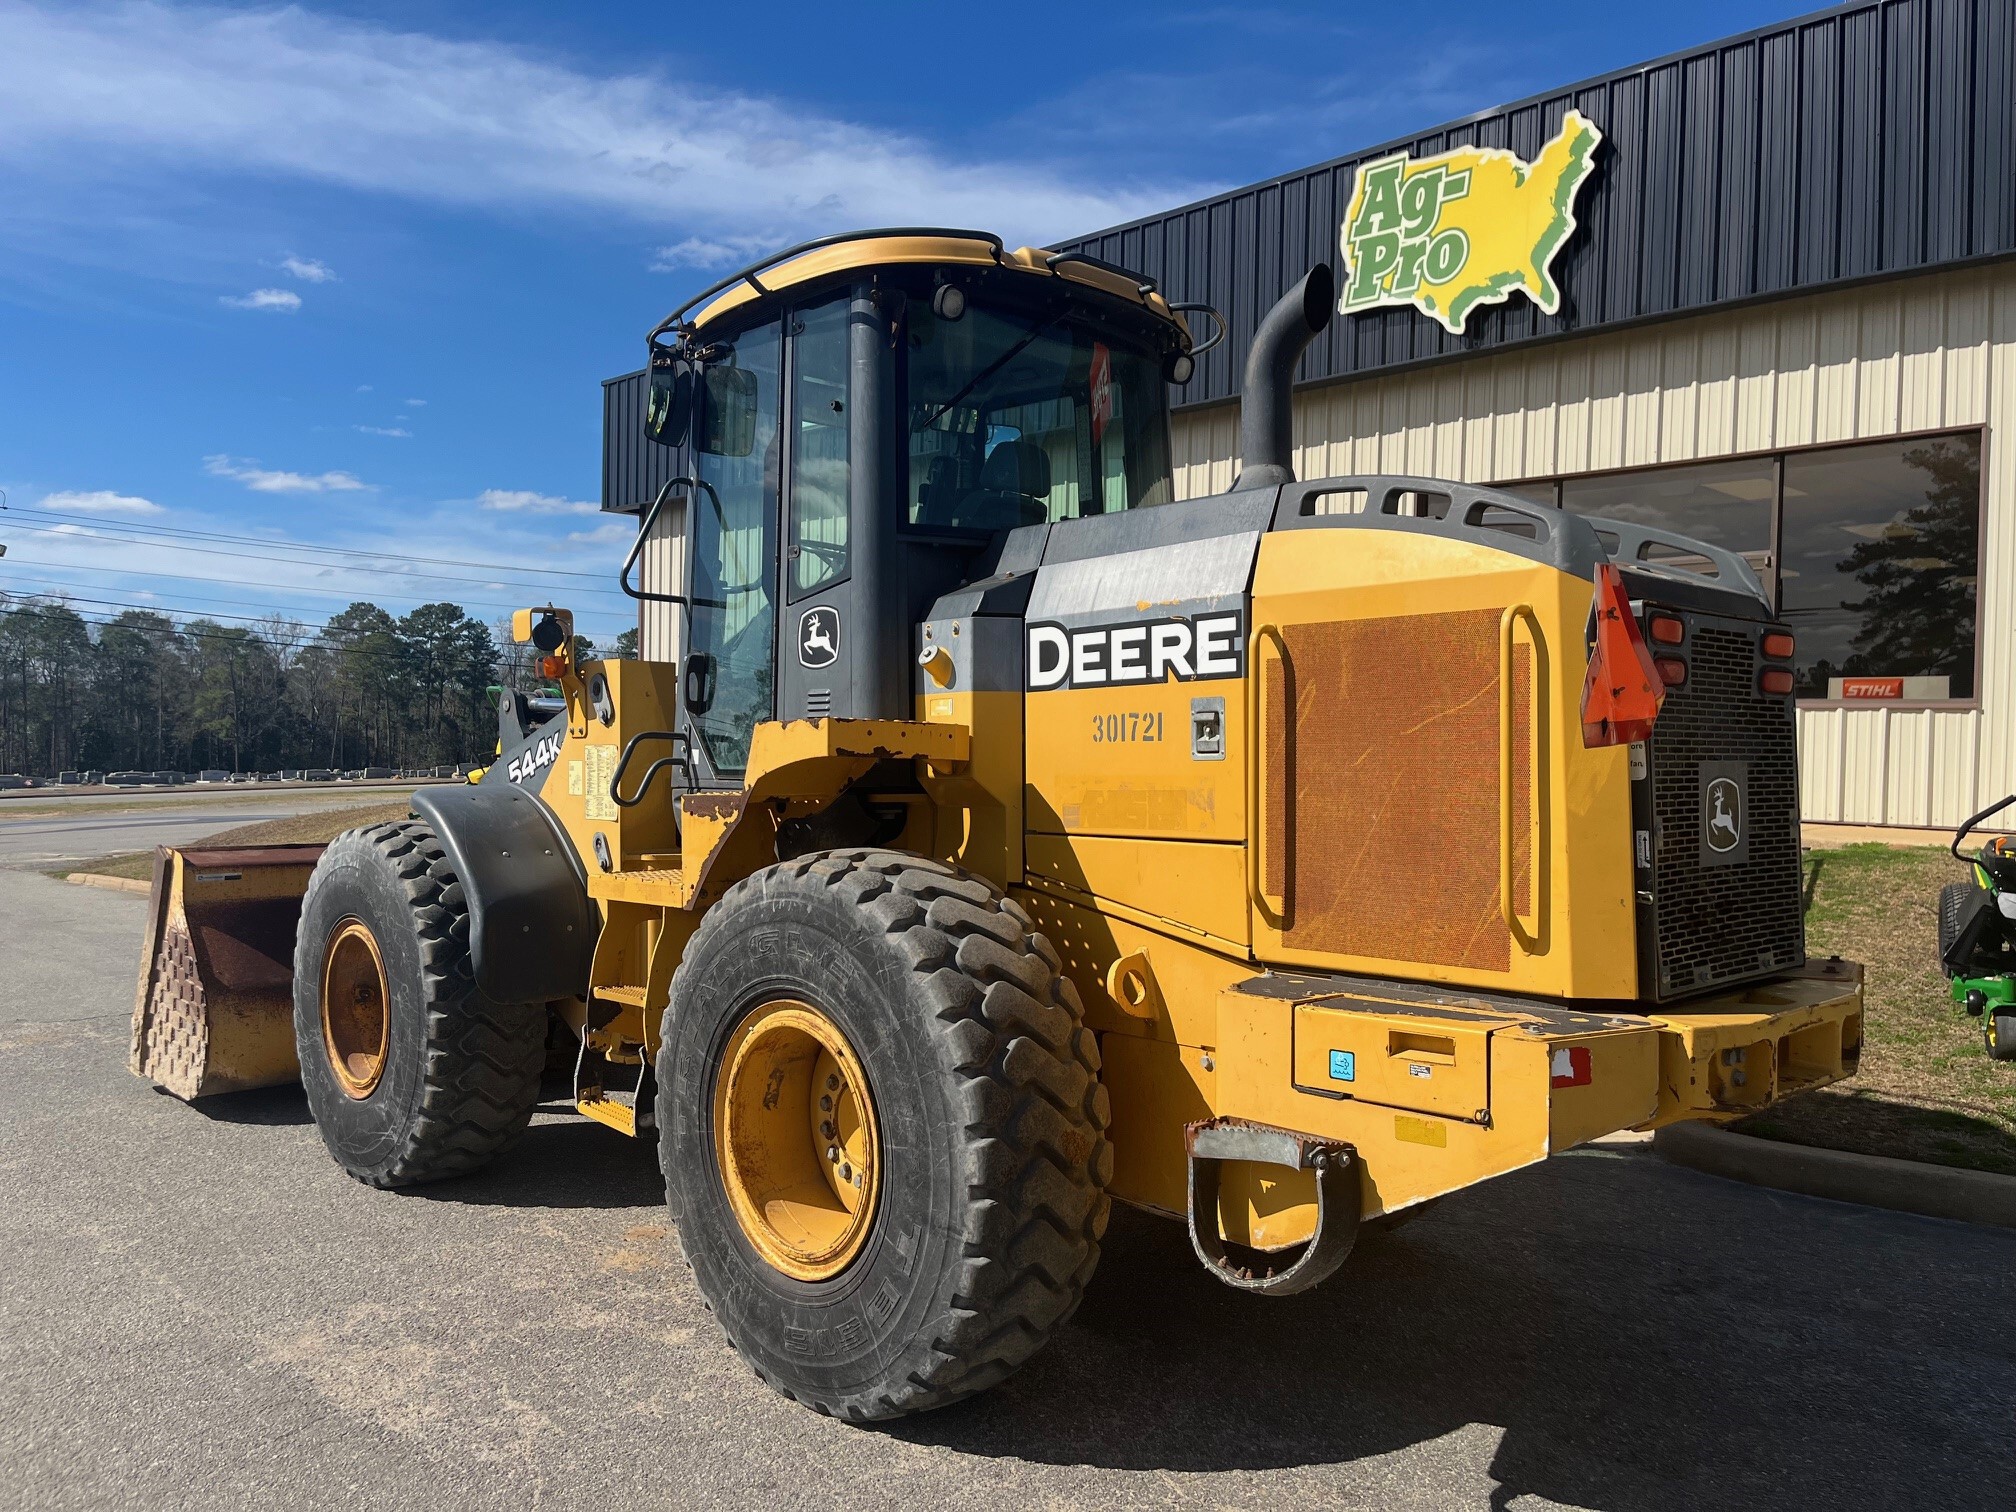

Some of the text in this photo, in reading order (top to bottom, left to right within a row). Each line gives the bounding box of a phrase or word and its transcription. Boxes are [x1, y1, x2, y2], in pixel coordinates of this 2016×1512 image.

[1349, 160, 1471, 242] Ag-
[1348, 228, 1470, 304] Pro
[1028, 614, 1238, 688] DEERE
[1846, 684, 1895, 697] STIHL
[507, 729, 562, 784] 544K
[1092, 712, 1163, 742] 301721
